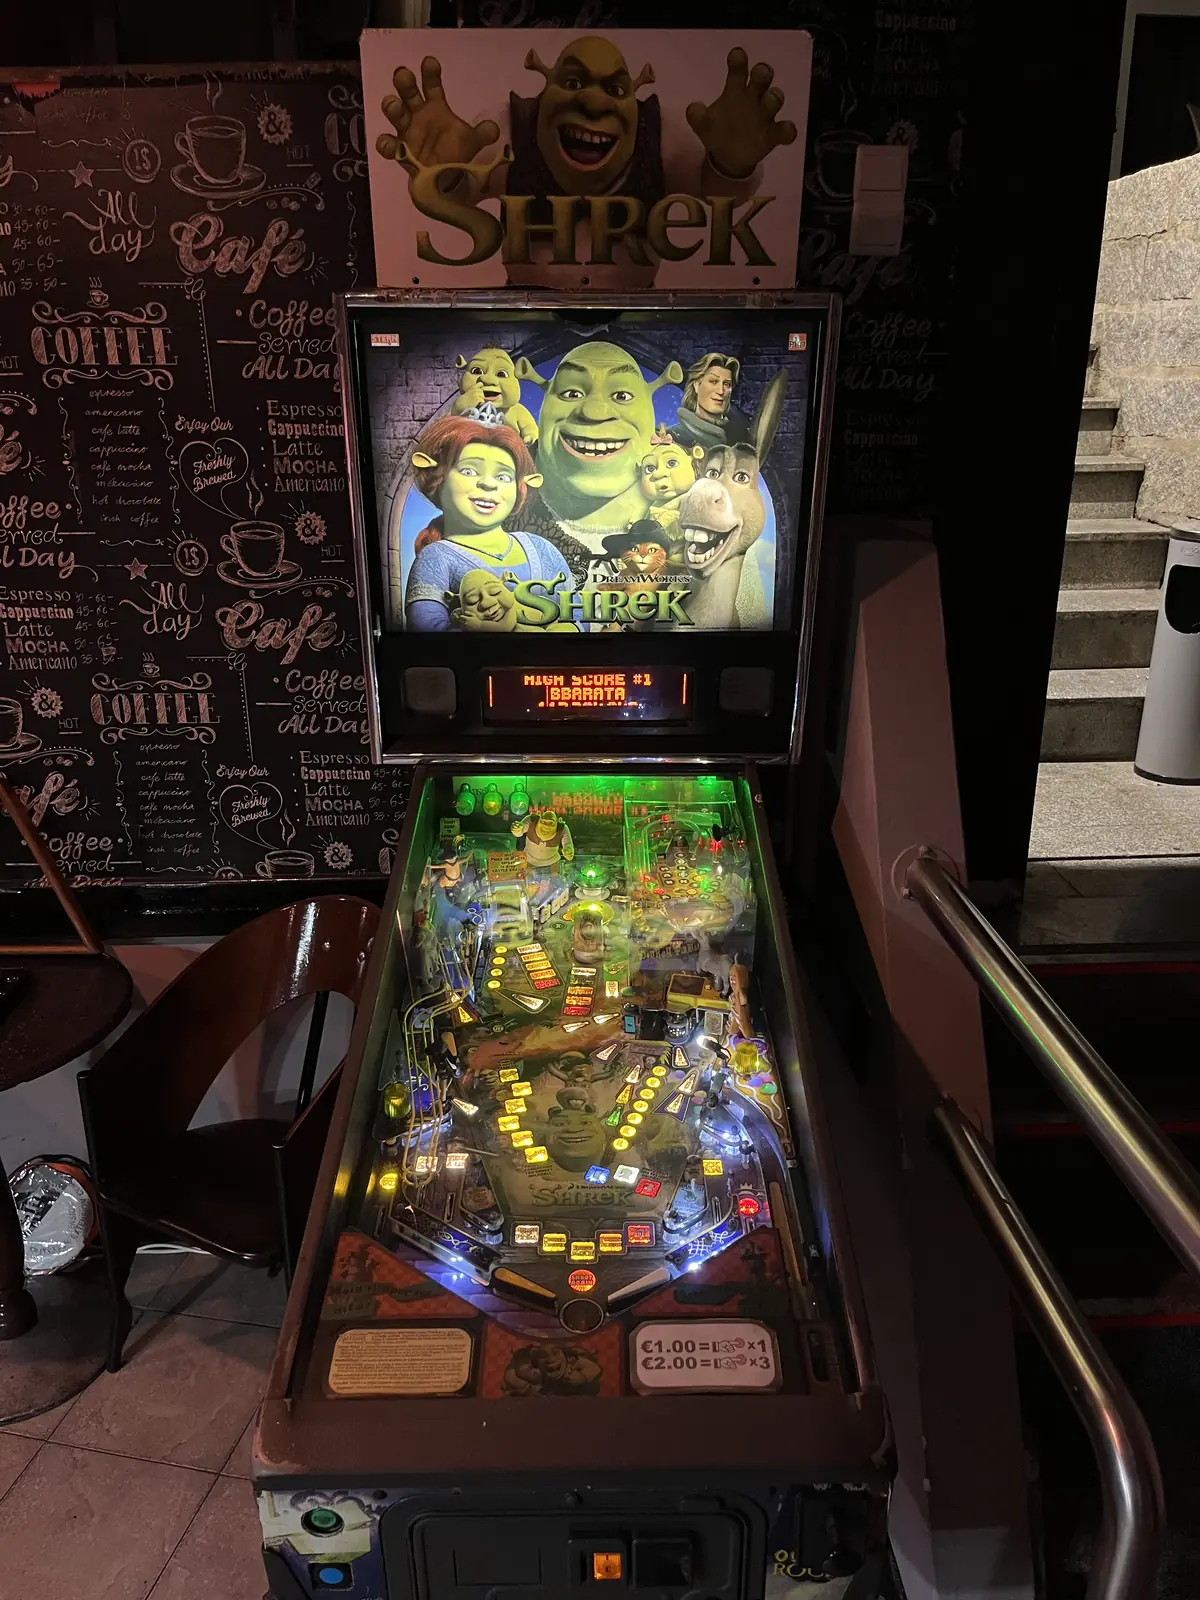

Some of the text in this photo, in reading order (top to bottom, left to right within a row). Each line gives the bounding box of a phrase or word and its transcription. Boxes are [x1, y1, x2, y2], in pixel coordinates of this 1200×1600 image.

[286, 145, 310, 160] HOT
[84, 188, 154, 229] All
[89, 217, 156, 263] day
[169, 212, 306, 295] Café
[250, 300, 338, 337] Coffee
[372, 335, 398, 344] STERN
[845, 311, 932, 349] Coffee
[30, 326, 180, 366] COFFEE
[258, 332, 340, 355] Served
[242, 355, 289, 380] All
[878, 367, 935, 402] Day
[266, 399, 343, 420] Espresso
[118, 424, 141, 436] latte
[174, 414, 234, 434] Enjoy Our
[267, 418, 344, 440] Cappuccino
[272, 439, 323, 456] Latte
[117, 461, 153, 472] mocha
[192, 454, 237, 476] Freshly
[273, 457, 338, 475] MOCHA
[192, 470, 237, 493] Brewed
[274, 475, 345, 493] Americano
[320, 545, 344, 557] HOT
[19, 547, 76, 580] Day
[0, 586, 71, 603] Espresso
[137, 581, 203, 613] All
[0, 602, 74, 622] Cappuccino
[4, 622, 54, 637] Latte
[142, 604, 202, 641] day
[214, 599, 338, 666] Café
[5, 637, 70, 654] MOCHA
[8, 654, 78, 671] Americano
[284, 669, 366, 700] Coffee
[571, 674, 626, 686] SCORE
[632, 674, 652, 686] #1
[550, 687, 626, 700] BBARATA
[90, 692, 222, 725] COFFEE
[292, 694, 368, 714] Served
[58, 717, 80, 728] HOT
[277, 713, 321, 735] All
[299, 750, 370, 765] Espresso
[164, 772, 186, 781] latte
[216, 764, 270, 779] Enjoy Our
[300, 766, 371, 782] Cappuccino
[303, 783, 351, 797] Latte
[231, 795, 271, 813] Freshly
[305, 797, 364, 812] MOCHA
[231, 808, 271, 828] Brewed
[305, 812, 370, 828] Americano
[39, 832, 114, 860] offee
